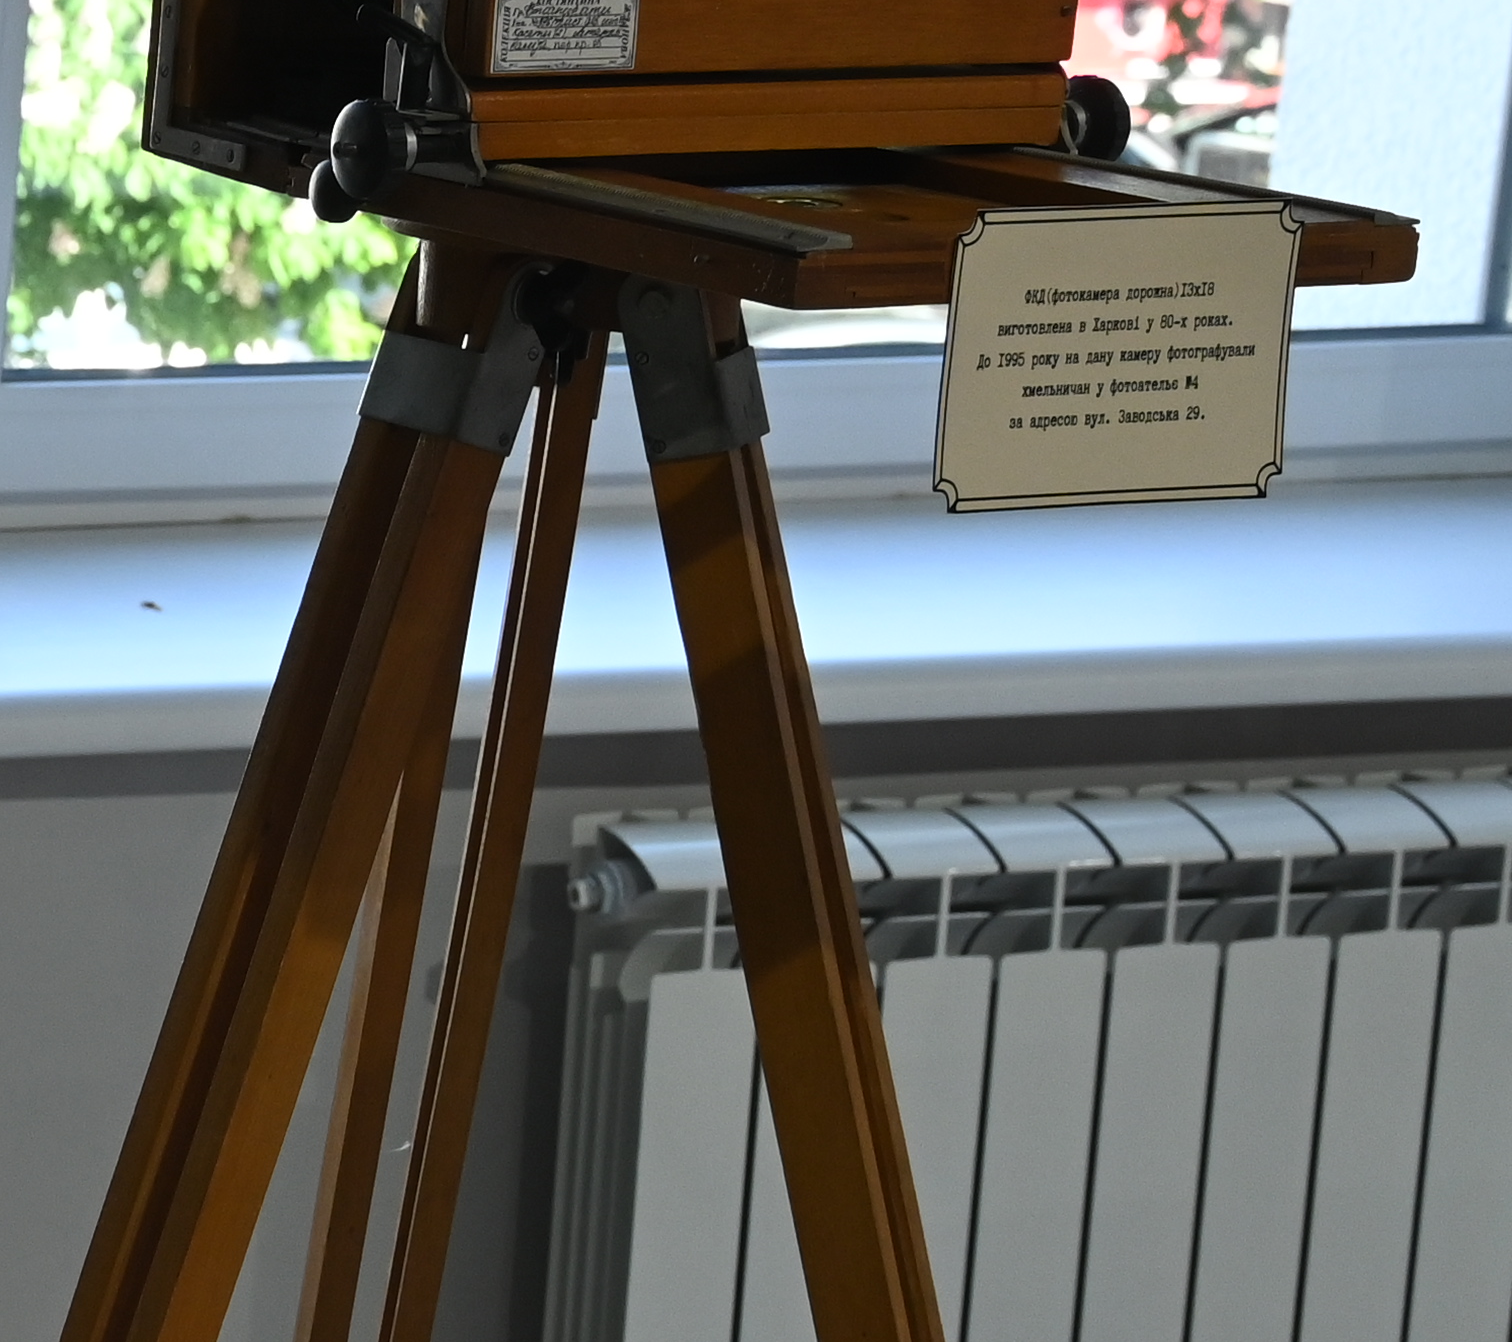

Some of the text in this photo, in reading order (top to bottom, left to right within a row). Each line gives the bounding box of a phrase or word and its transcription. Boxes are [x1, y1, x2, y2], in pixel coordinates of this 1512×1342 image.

[1024, 287, 1120, 306] ФКД(фотокамера
[997, 314, 1233, 337] виготовлена в Харкові у 80-х роках.
[976, 342, 1256, 371] До 1995 року на дану камеру фотографували
[1021, 382, 1091, 397] хмельничан
[1095, 382, 1104, 398] у
[1109, 378, 1179, 397] фотоательє
[1008, 405, 1205, 432] за адресою вул. Заводська 29.
